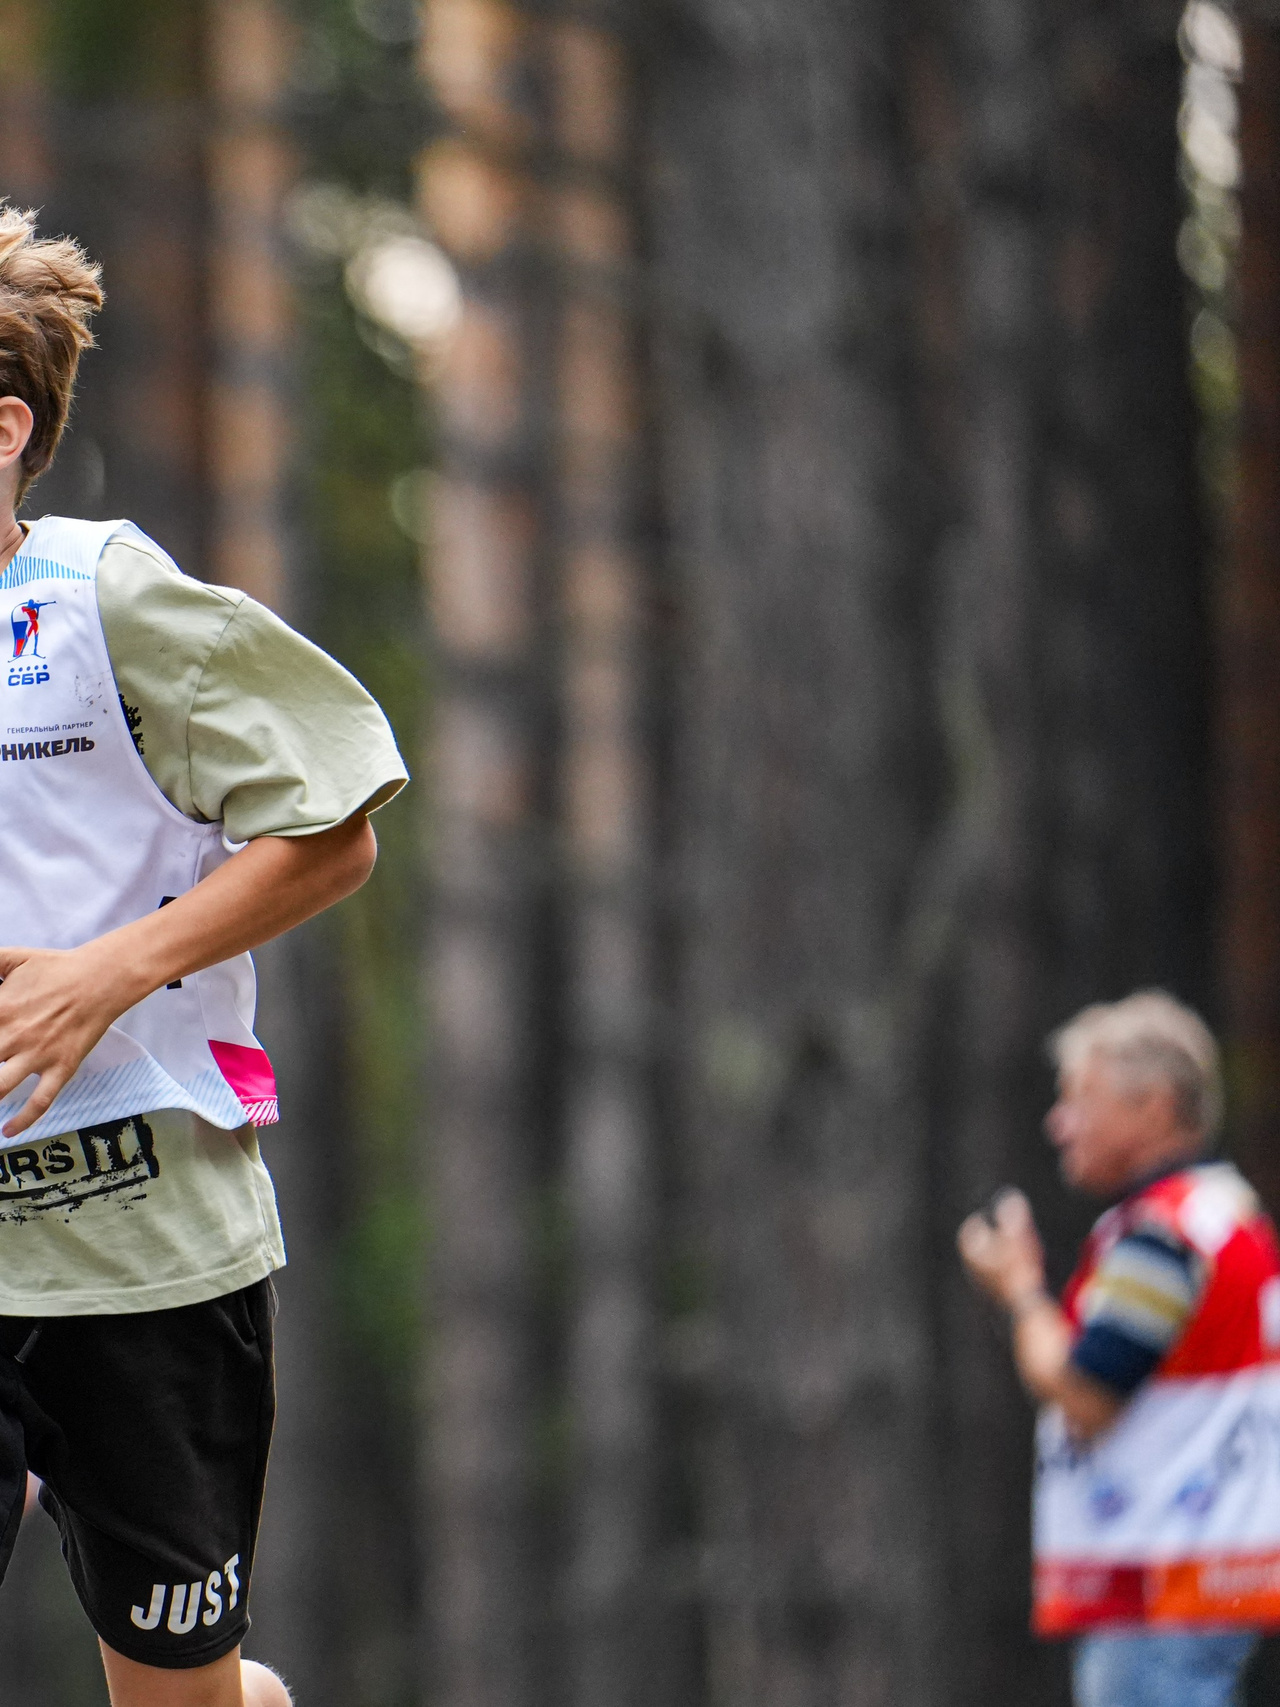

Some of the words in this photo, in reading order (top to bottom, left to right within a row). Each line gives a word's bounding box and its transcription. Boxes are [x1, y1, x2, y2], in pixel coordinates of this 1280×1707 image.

[8, 672, 50, 686] СБР
[7, 724, 60, 734] ГЕНЕРАЛЬНЫЙ
[62, 721, 94, 731] ПАРТНЕР
[130, 1553, 239, 1635] JUST
